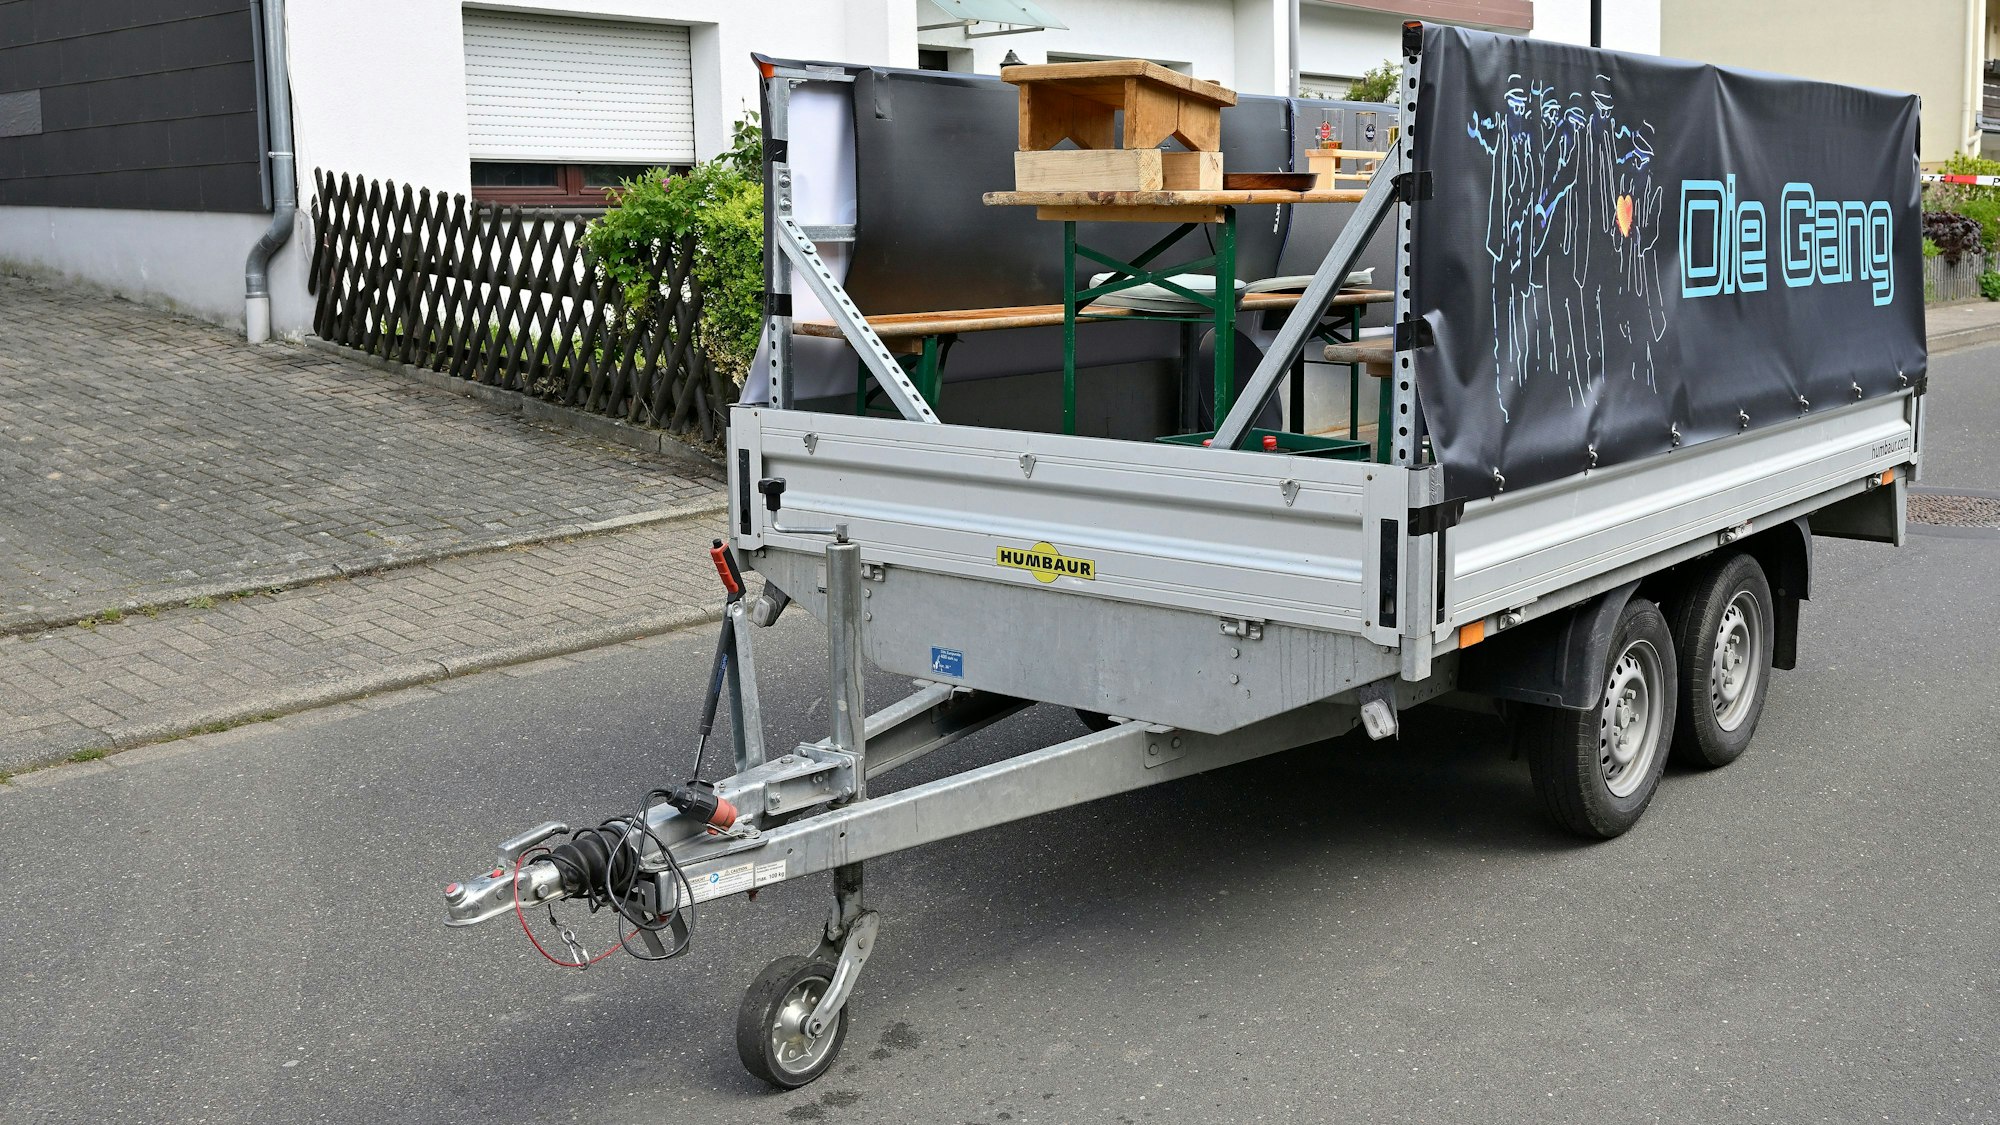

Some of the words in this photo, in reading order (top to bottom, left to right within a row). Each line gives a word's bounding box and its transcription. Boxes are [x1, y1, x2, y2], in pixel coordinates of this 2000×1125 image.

[1679, 173, 1767, 299] Die
[1780, 182, 1895, 307] Gang
[1000, 550, 1091, 576] HUMBAUR
